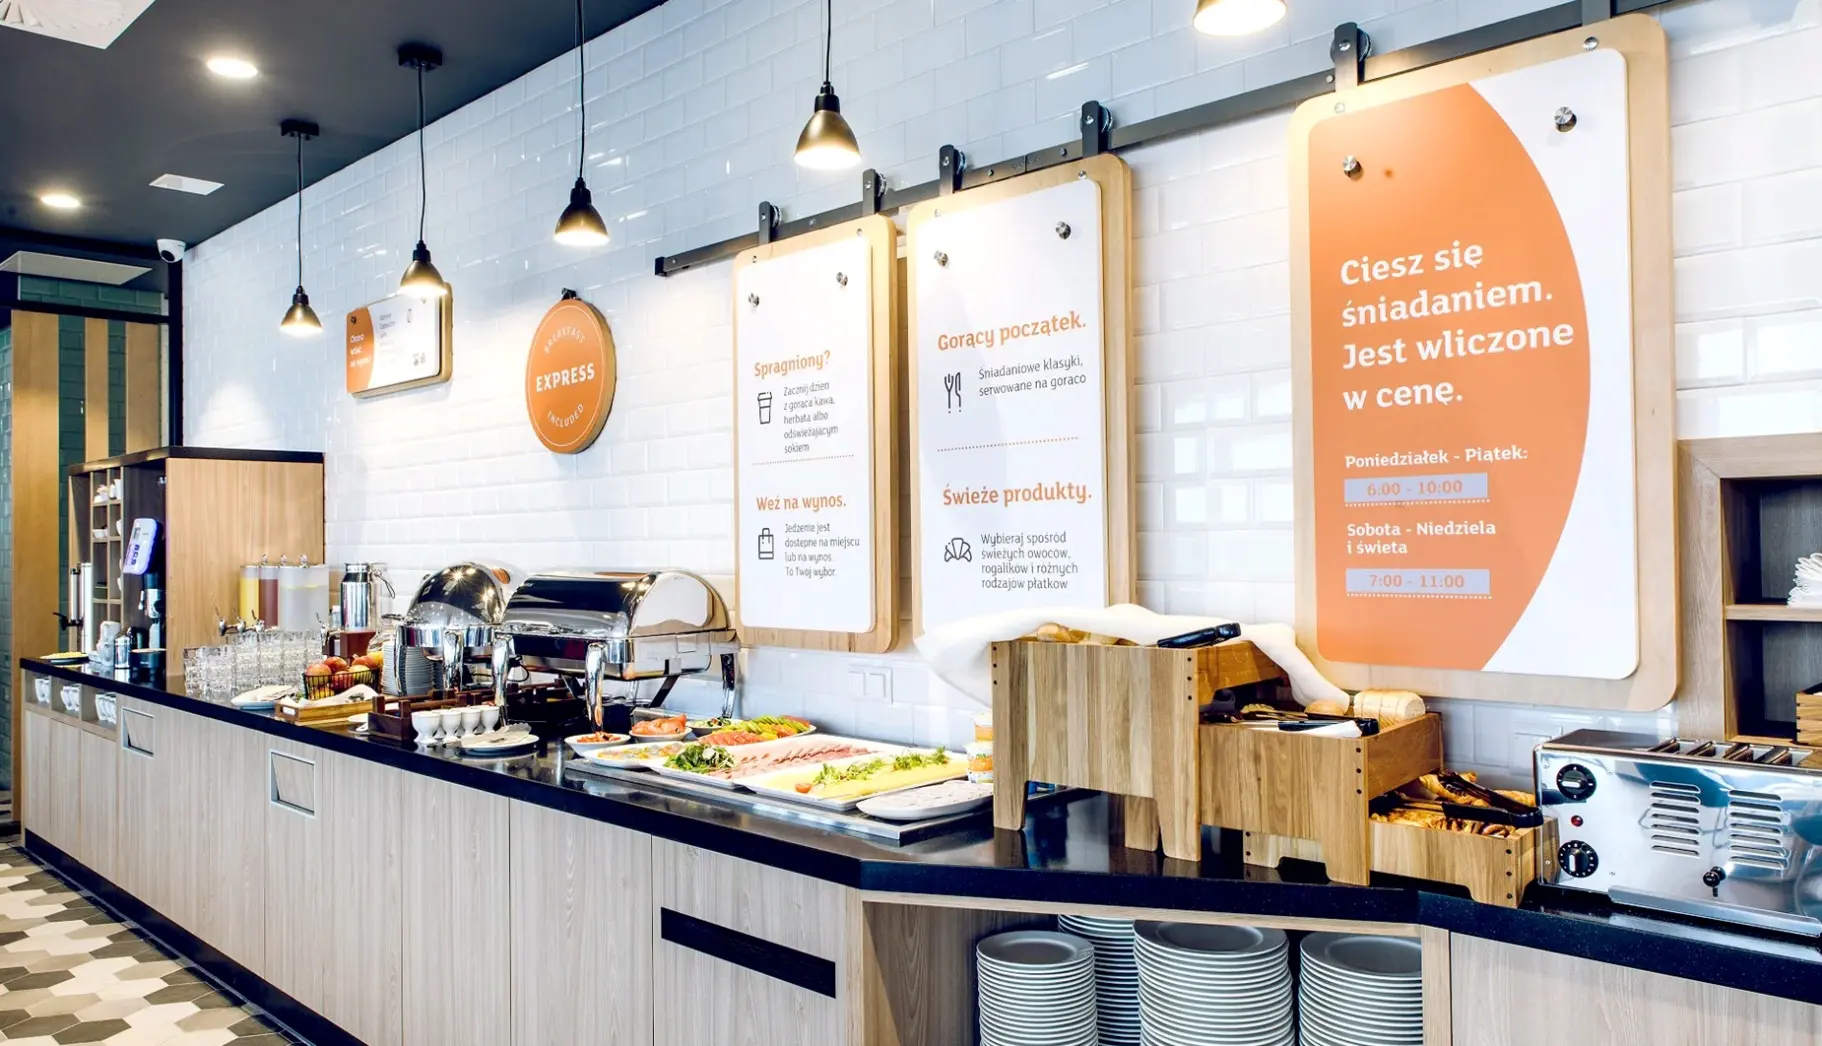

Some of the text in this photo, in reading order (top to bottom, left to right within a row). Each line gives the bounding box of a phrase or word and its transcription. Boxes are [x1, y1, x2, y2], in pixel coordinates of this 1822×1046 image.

[1341, 240, 1483, 285] Ciesz się
[1342, 280, 1553, 327] śniadaniem.
[938, 311, 1086, 351] Gorący początek.
[1342, 323, 1574, 369] Jest wliczone
[754, 350, 831, 379] Spragniony?
[979, 355, 1083, 380] Śniadaniowe klasyki,
[536, 362, 595, 392] EXPRESS
[979, 381, 1032, 396] serwowane
[1035, 380, 1048, 389] na
[1343, 381, 1463, 410] w cenę.
[548, 404, 584, 428] INCLUDED
[784, 442, 810, 453] sokiem
[1345, 449, 1449, 469] Poniedziałek
[1465, 445, 1528, 463] Piątek:
[943, 481, 1092, 507] Świeże produkty.
[1367, 483, 1400, 496] 6:00
[1418, 480, 1463, 494] 10:00
[756, 495, 847, 513] Weź na wynos.
[785, 522, 831, 535] Jedzenie jest
[1347, 522, 1401, 536] Sobota
[1416, 520, 1497, 535] Niedziela
[819, 539, 828, 547] na
[830, 536, 860, 549] miejscu
[981, 532, 1024, 547] Wybieraj
[1347, 540, 1352, 554] i
[785, 552, 796, 562] lub
[798, 553, 807, 562] na
[981, 547, 1025, 561] świeżych
[785, 567, 794, 576] To
[1370, 575, 1402, 587] 7:00
[1420, 575, 1465, 588] 11:00
